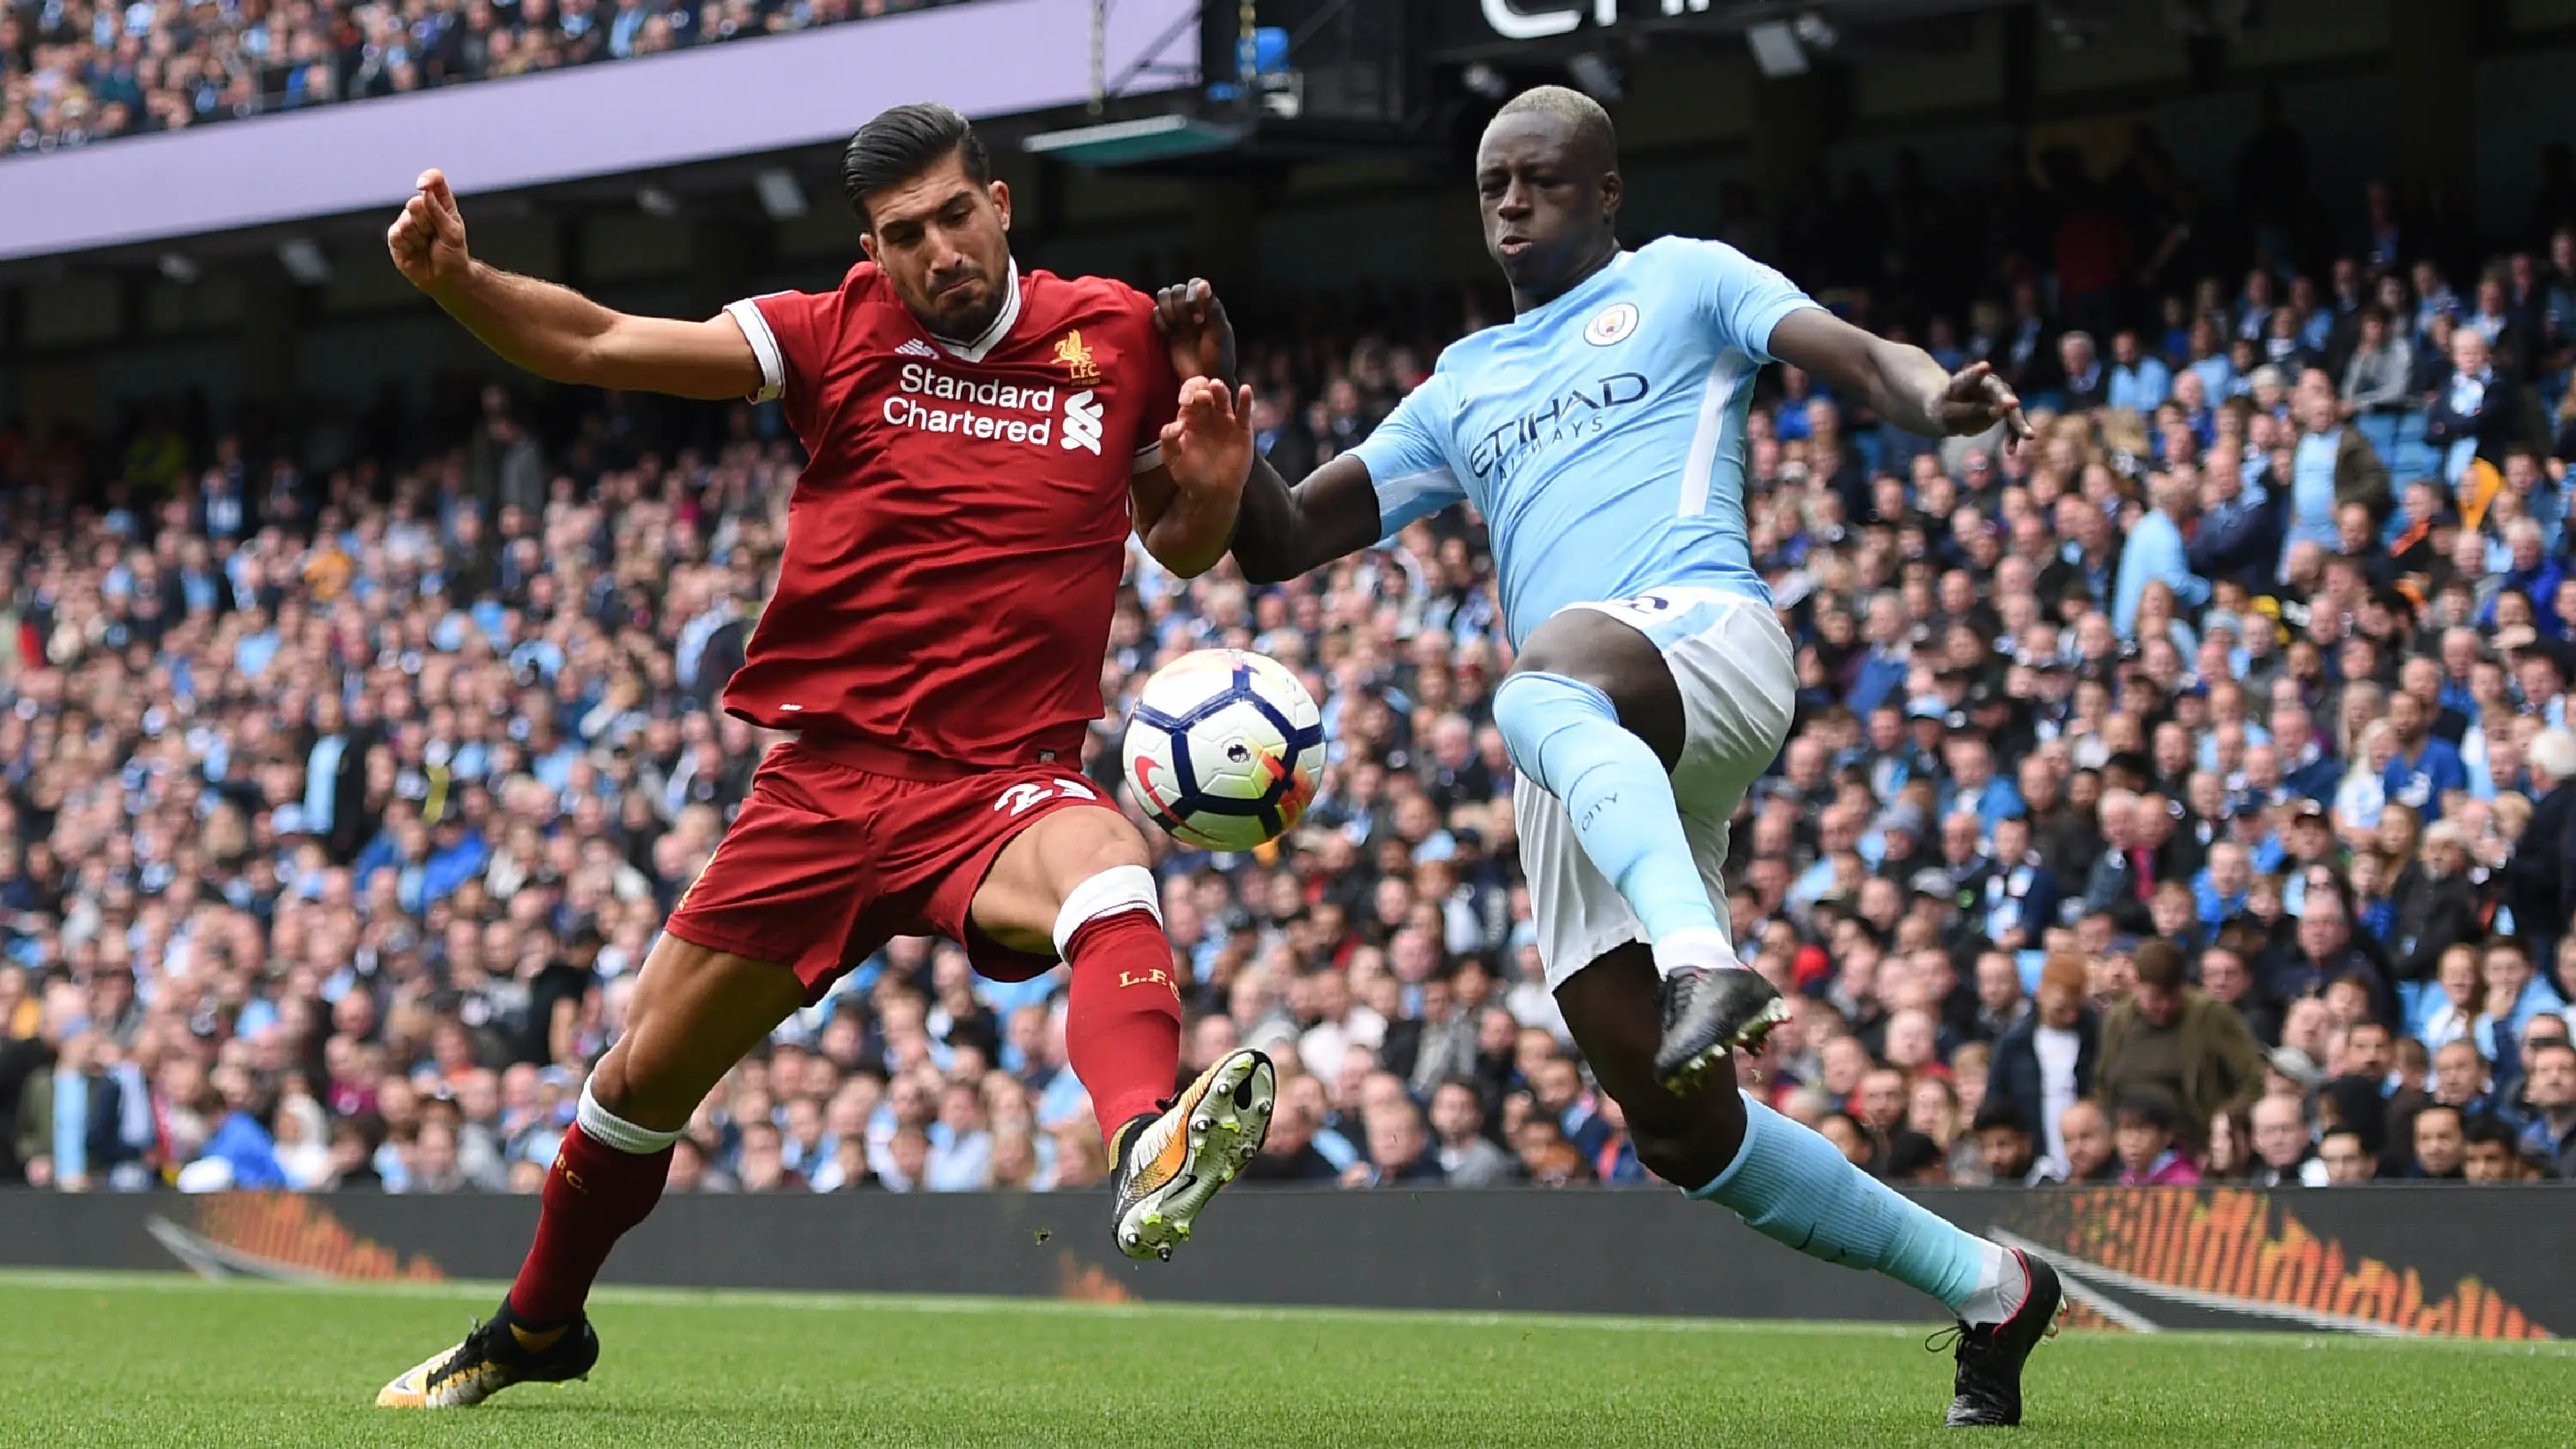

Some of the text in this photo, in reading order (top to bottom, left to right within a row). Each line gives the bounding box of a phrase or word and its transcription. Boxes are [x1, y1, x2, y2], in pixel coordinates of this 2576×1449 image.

[900, 363, 1054, 411] Standard
[883, 397, 1051, 446] Chartered
[1471, 372, 1649, 478] ETIHAD
